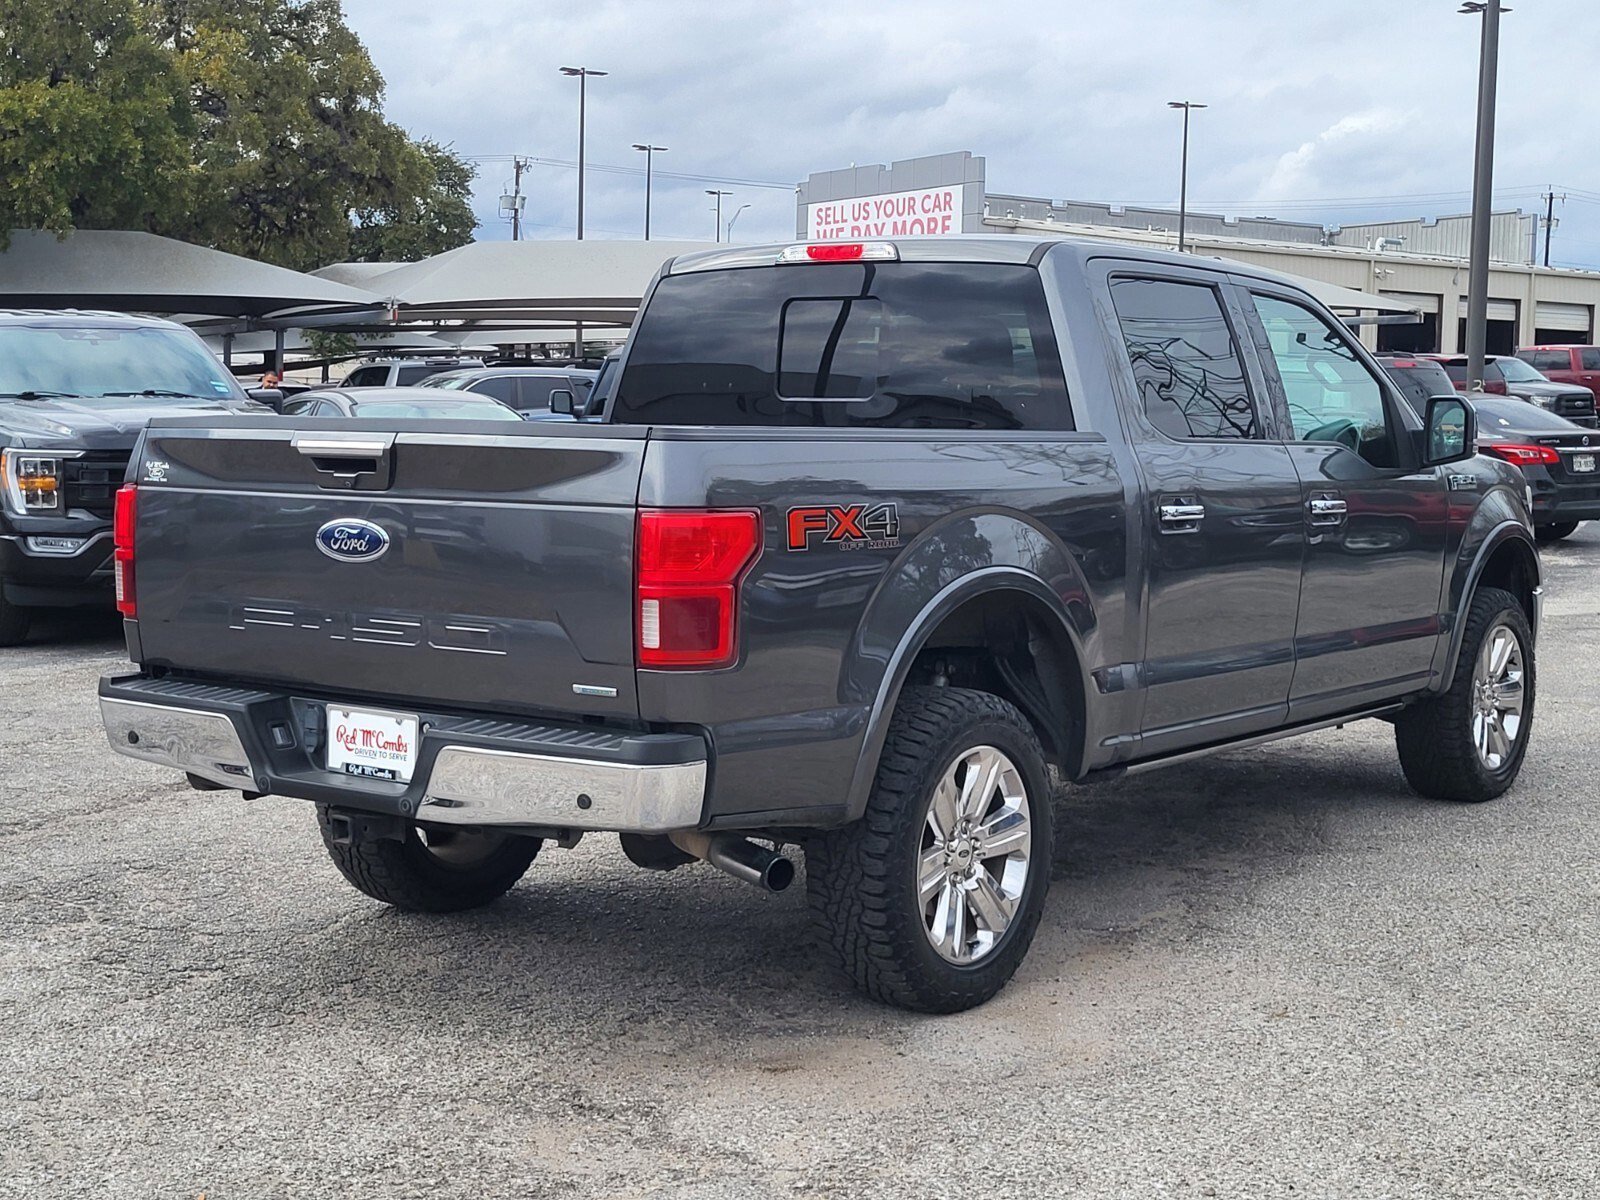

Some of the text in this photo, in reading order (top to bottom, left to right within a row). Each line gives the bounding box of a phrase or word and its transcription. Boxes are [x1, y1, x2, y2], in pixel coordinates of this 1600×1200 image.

[816, 191, 953, 226] SELL US YOUR CAR
[892, 214, 952, 236] MORE
[330, 526, 370, 552] Ford
[786, 502, 900, 552] FX4
[336, 724, 408, 753] Red McCombs
[355, 747, 408, 761] DRIVEN TO SERVE
